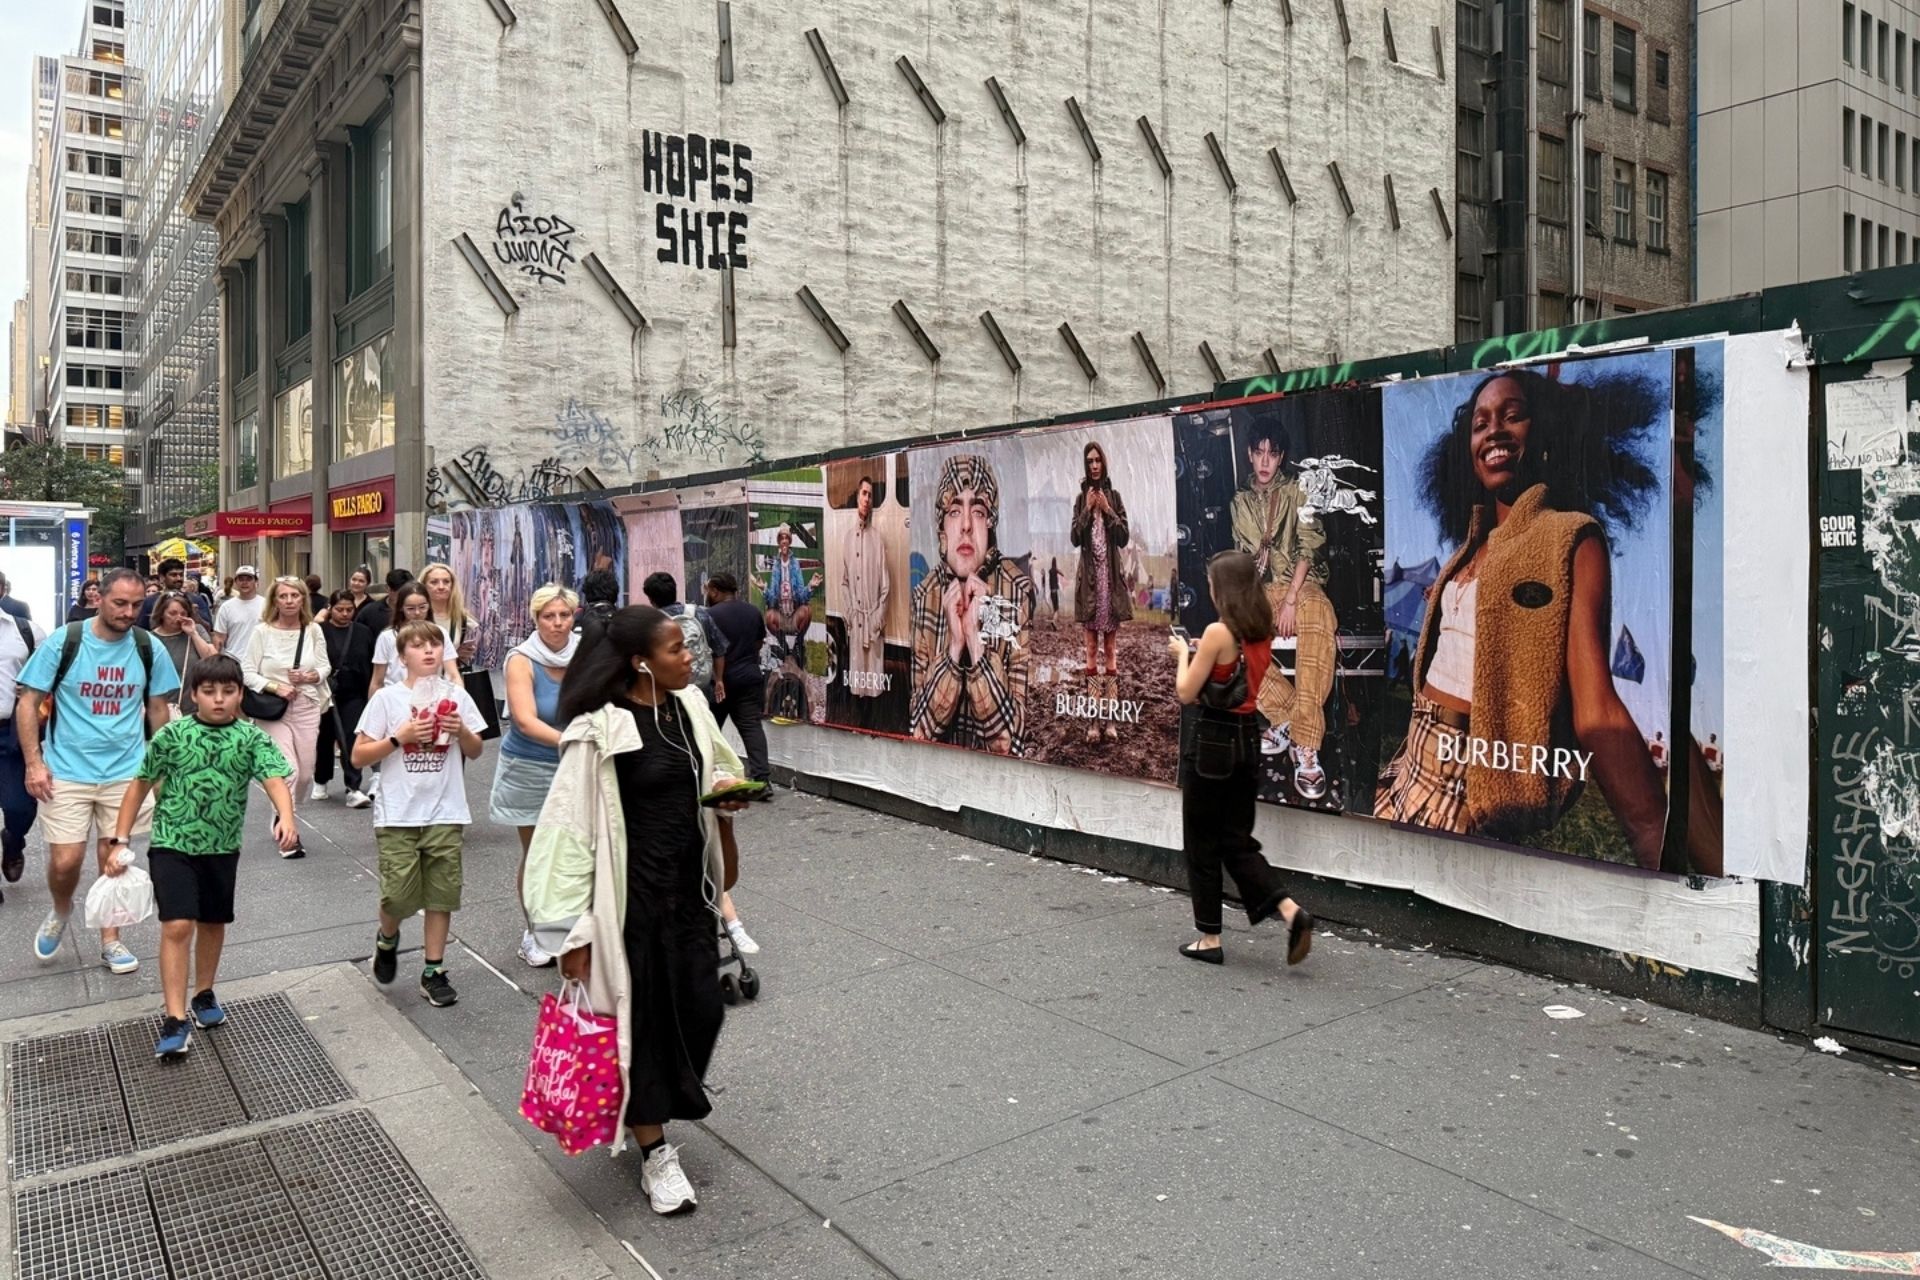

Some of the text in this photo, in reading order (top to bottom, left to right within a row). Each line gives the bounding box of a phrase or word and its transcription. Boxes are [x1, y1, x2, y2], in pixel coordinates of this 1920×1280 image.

[643, 129, 753, 204] HOPES
[656, 202, 748, 270] SHIE
[333, 491, 382, 518] WELLS FARGO
[226, 516, 303, 526] WELLS FARGO
[1820, 515, 1856, 532] GOUR
[1821, 531, 1857, 547] HEKTIC
[71, 539, 80, 569] Avenue
[97, 666, 125, 682] WIN
[843, 670, 893, 692] BURBERRY
[92, 700, 121, 715] WIN
[1055, 694, 1145, 723] BURBERRY
[1436, 733, 1594, 781] BURBERRY
